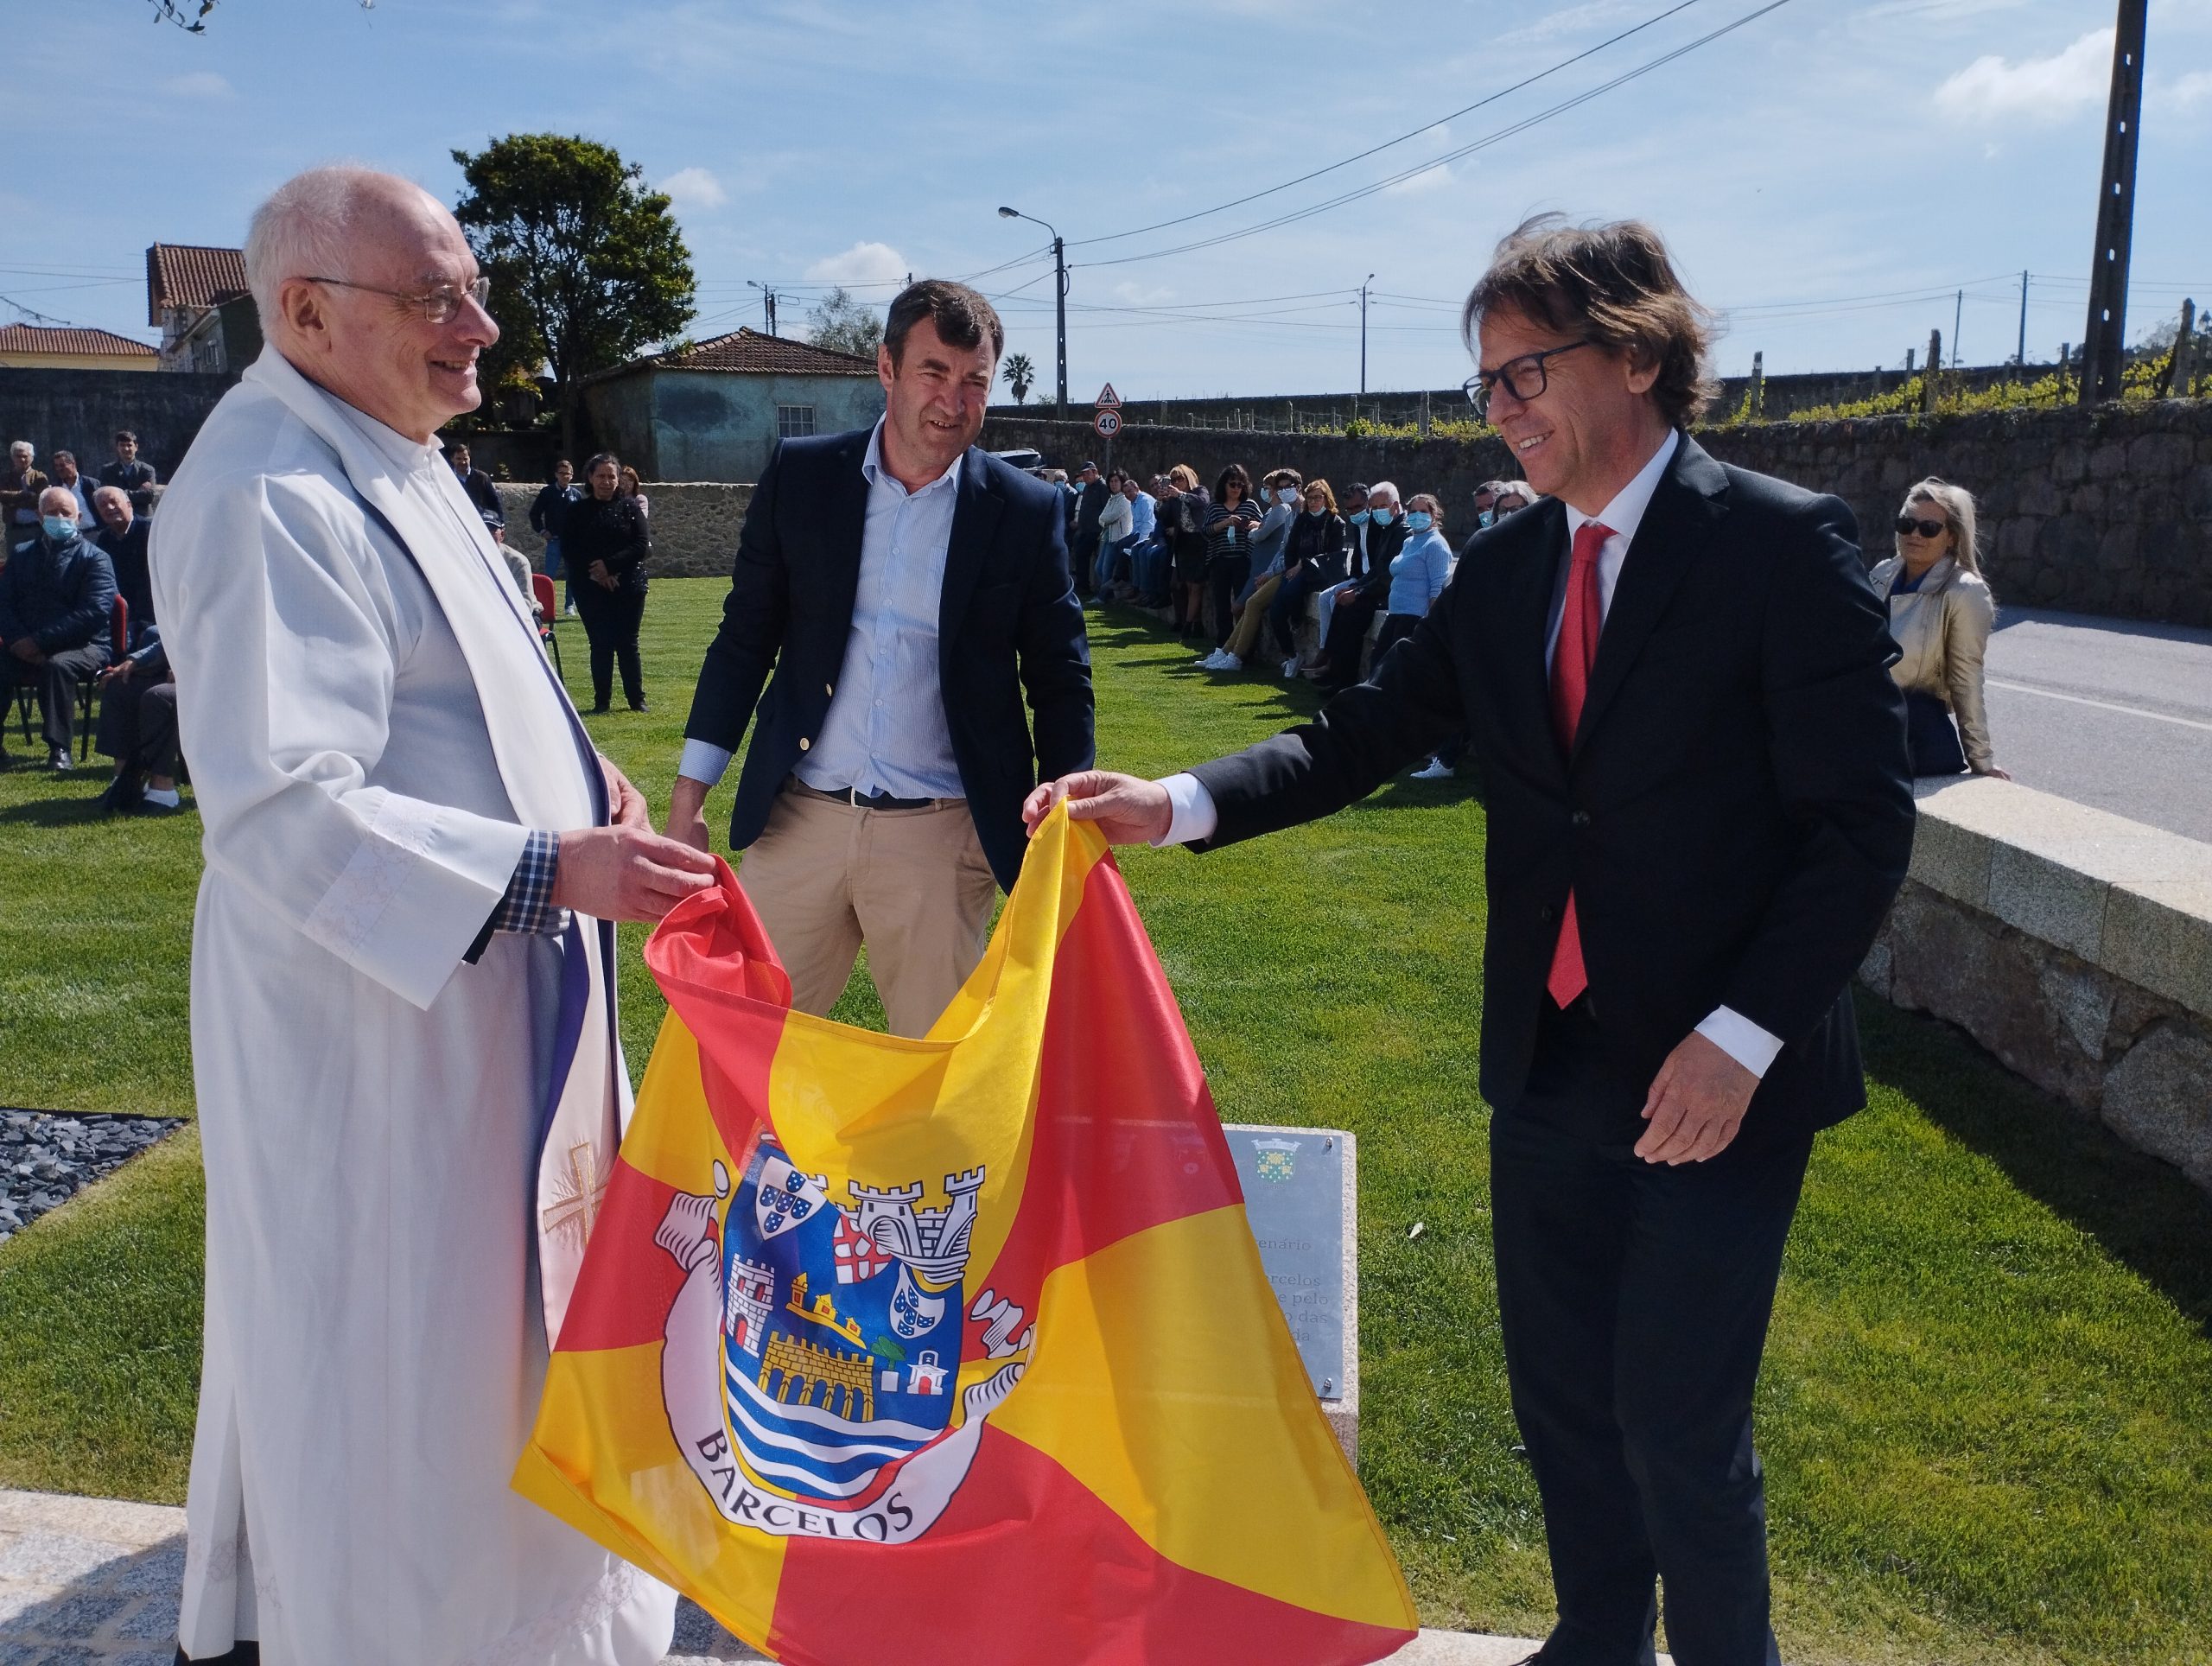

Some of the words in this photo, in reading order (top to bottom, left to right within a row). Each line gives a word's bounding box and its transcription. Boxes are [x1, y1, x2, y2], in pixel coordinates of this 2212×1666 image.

[1099, 418, 1117, 429] 40
[1257, 1237, 1312, 1251] enário
[1265, 1273, 1321, 1287] rcelos
[1292, 1293, 1329, 1307] pelo
[1298, 1310, 1328, 1324] das
[696, 1428, 913, 1542] BARCELOS
